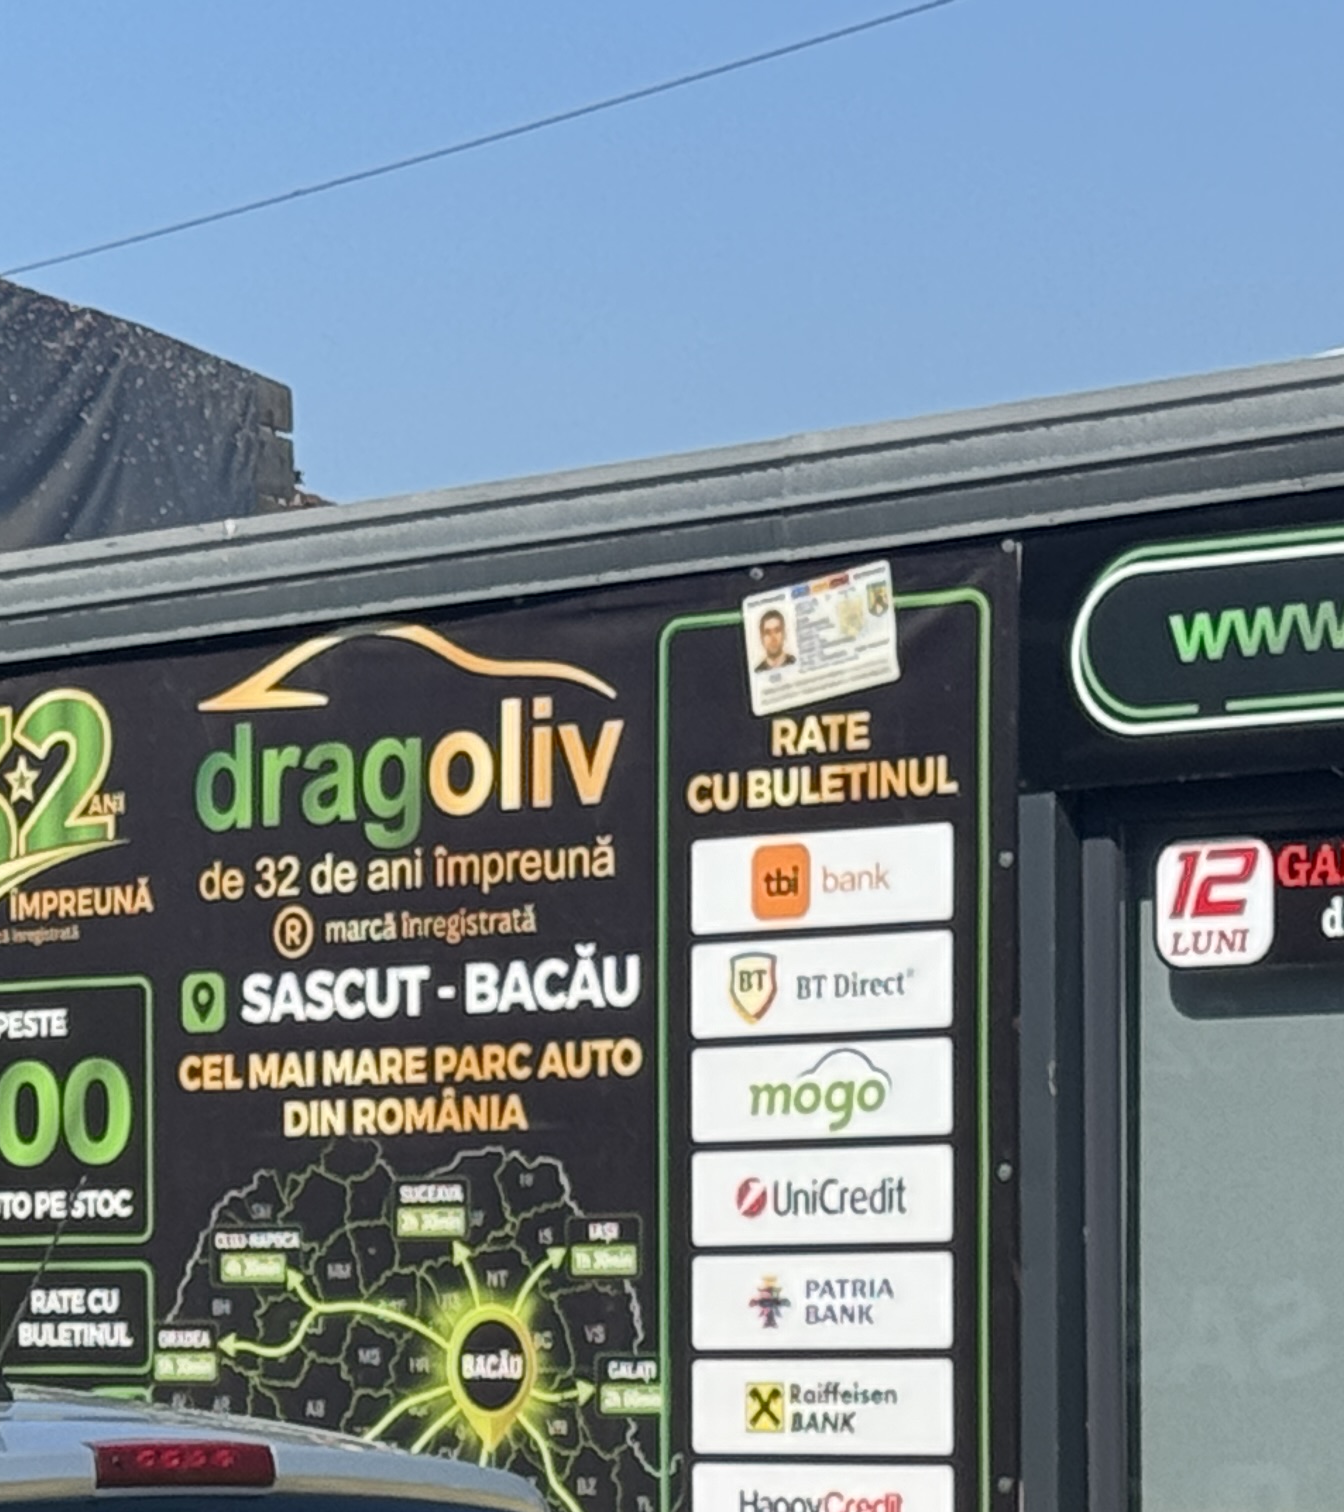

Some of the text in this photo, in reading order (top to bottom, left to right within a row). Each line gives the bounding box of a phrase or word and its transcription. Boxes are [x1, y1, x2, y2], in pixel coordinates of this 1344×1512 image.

[771, 711, 872, 756] RATE
[195, 696, 625, 849] dragoliv
[686, 755, 960, 814] CU BULETINUL
[198, 835, 617, 901] de 32 de ani împreună
[762, 862, 891, 898] tbi bank
[1168, 846, 1259, 920] 12
[1276, 843, 1344, 888] GA
[324, 912, 398, 943] marcă
[400, 904, 538, 945] înregistrată
[1170, 928, 1250, 957] LUNI
[241, 966, 431, 1025] SASCUT
[465, 943, 641, 1015] BACĂU
[739, 969, 906, 1000] BT BT Direct
[178, 1037, 644, 1092] CEL MAI MARE PARC AUTO
[283, 1087, 529, 1138] DIN ROMÂNIA
[748, 1079, 887, 1132] mogo
[33, 1189, 67, 1219] PE
[70, 1188, 134, 1220] STOC
[772, 1176, 908, 1217] UniCredit
[30, 1286, 121, 1316] RATE CU
[804, 1278, 895, 1300] PATRIA
[18, 1320, 135, 1348] BULETINUL
[804, 1303, 875, 1326] BANK
[461, 1349, 524, 1381] BACĂU
[789, 1382, 899, 1406] Raiffeisen
[789, 1410, 857, 1434] BANK
